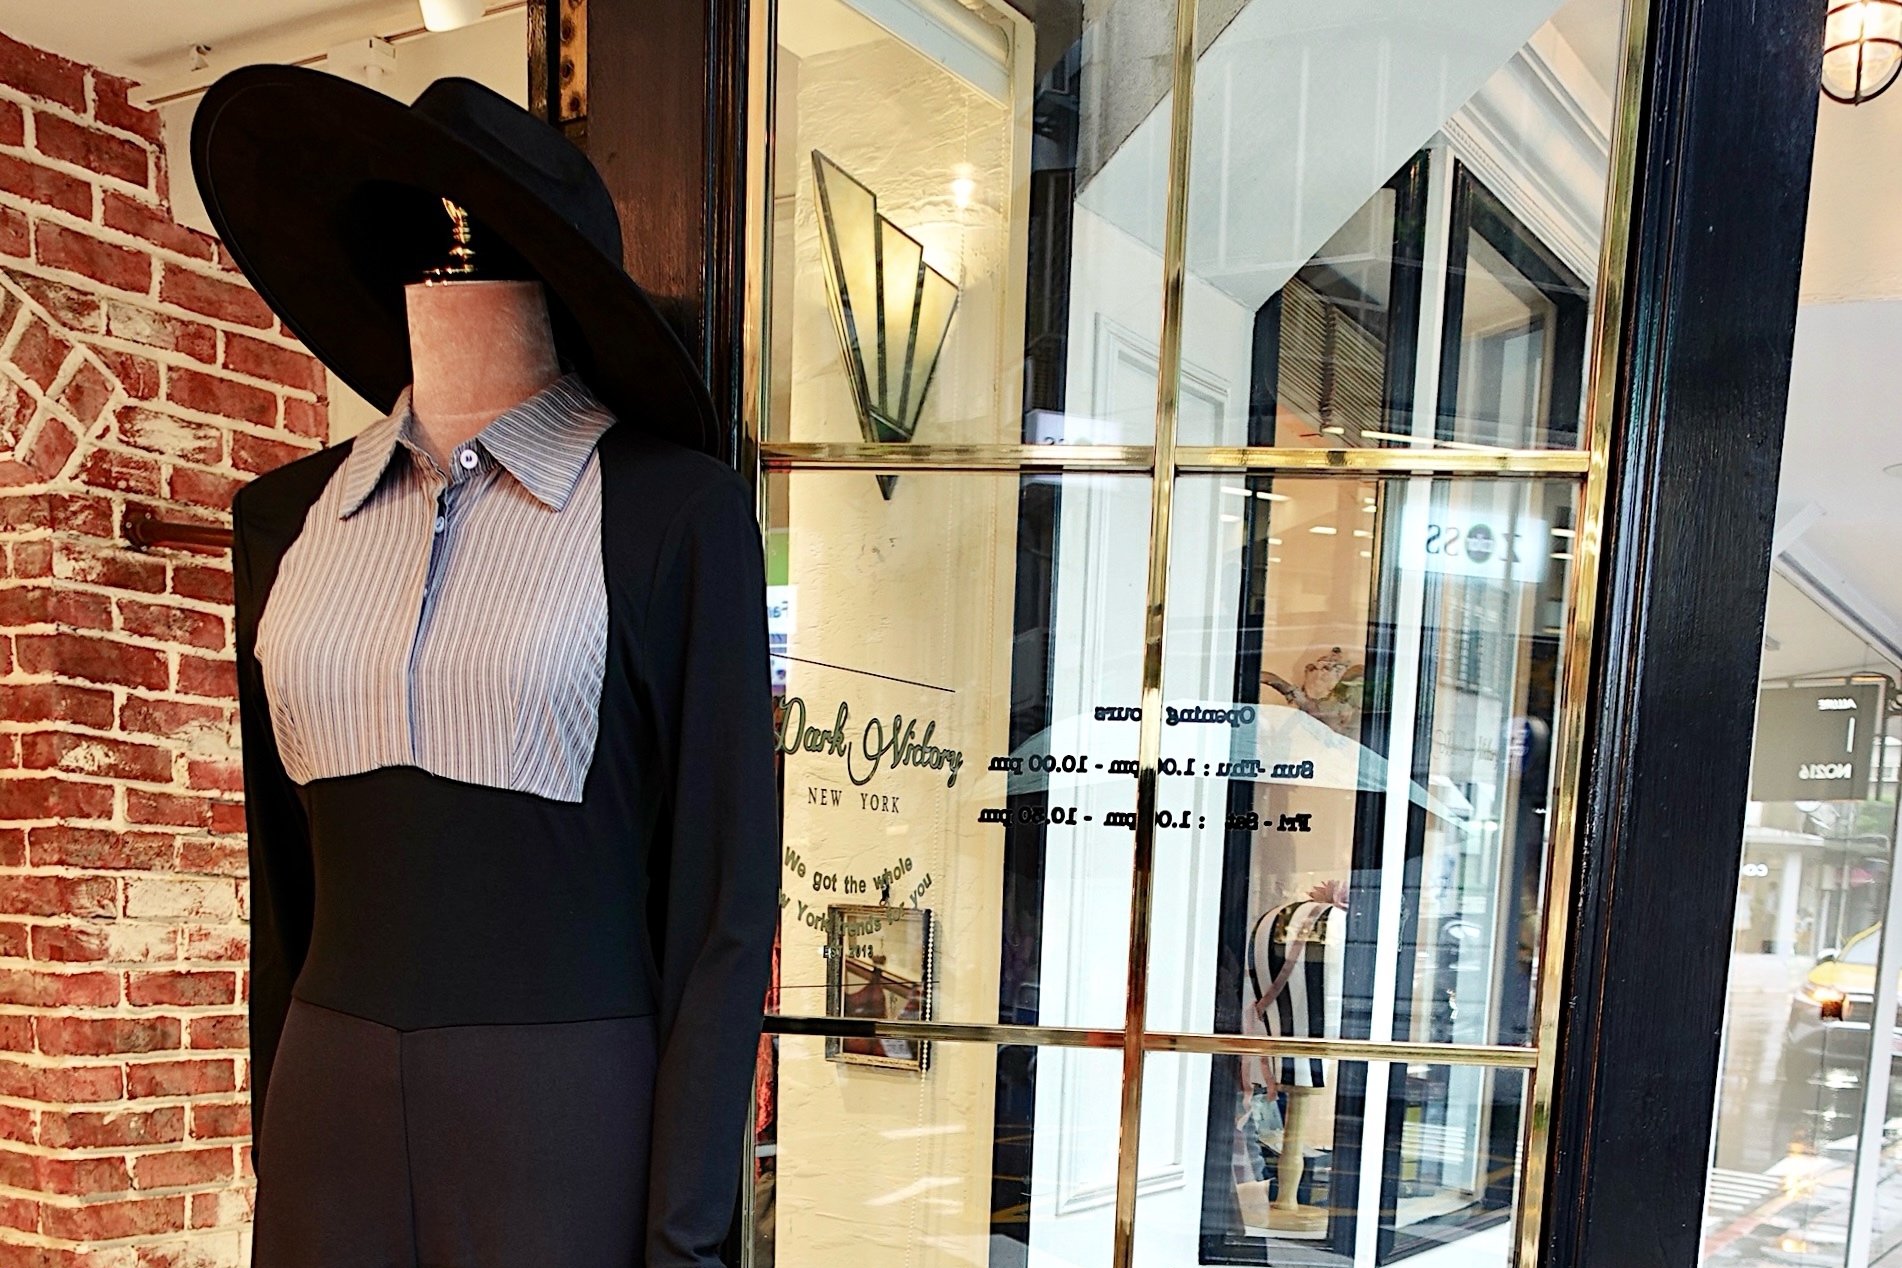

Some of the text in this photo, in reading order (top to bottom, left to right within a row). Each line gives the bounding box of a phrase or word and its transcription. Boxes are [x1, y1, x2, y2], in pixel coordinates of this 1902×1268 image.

[774, 696, 964, 788] Dark Victory
[807, 786, 900, 814] NEW YORK
[784, 845, 913, 894] We got the whole
[797, 899, 834, 935] York
[909, 872, 933, 910] you
